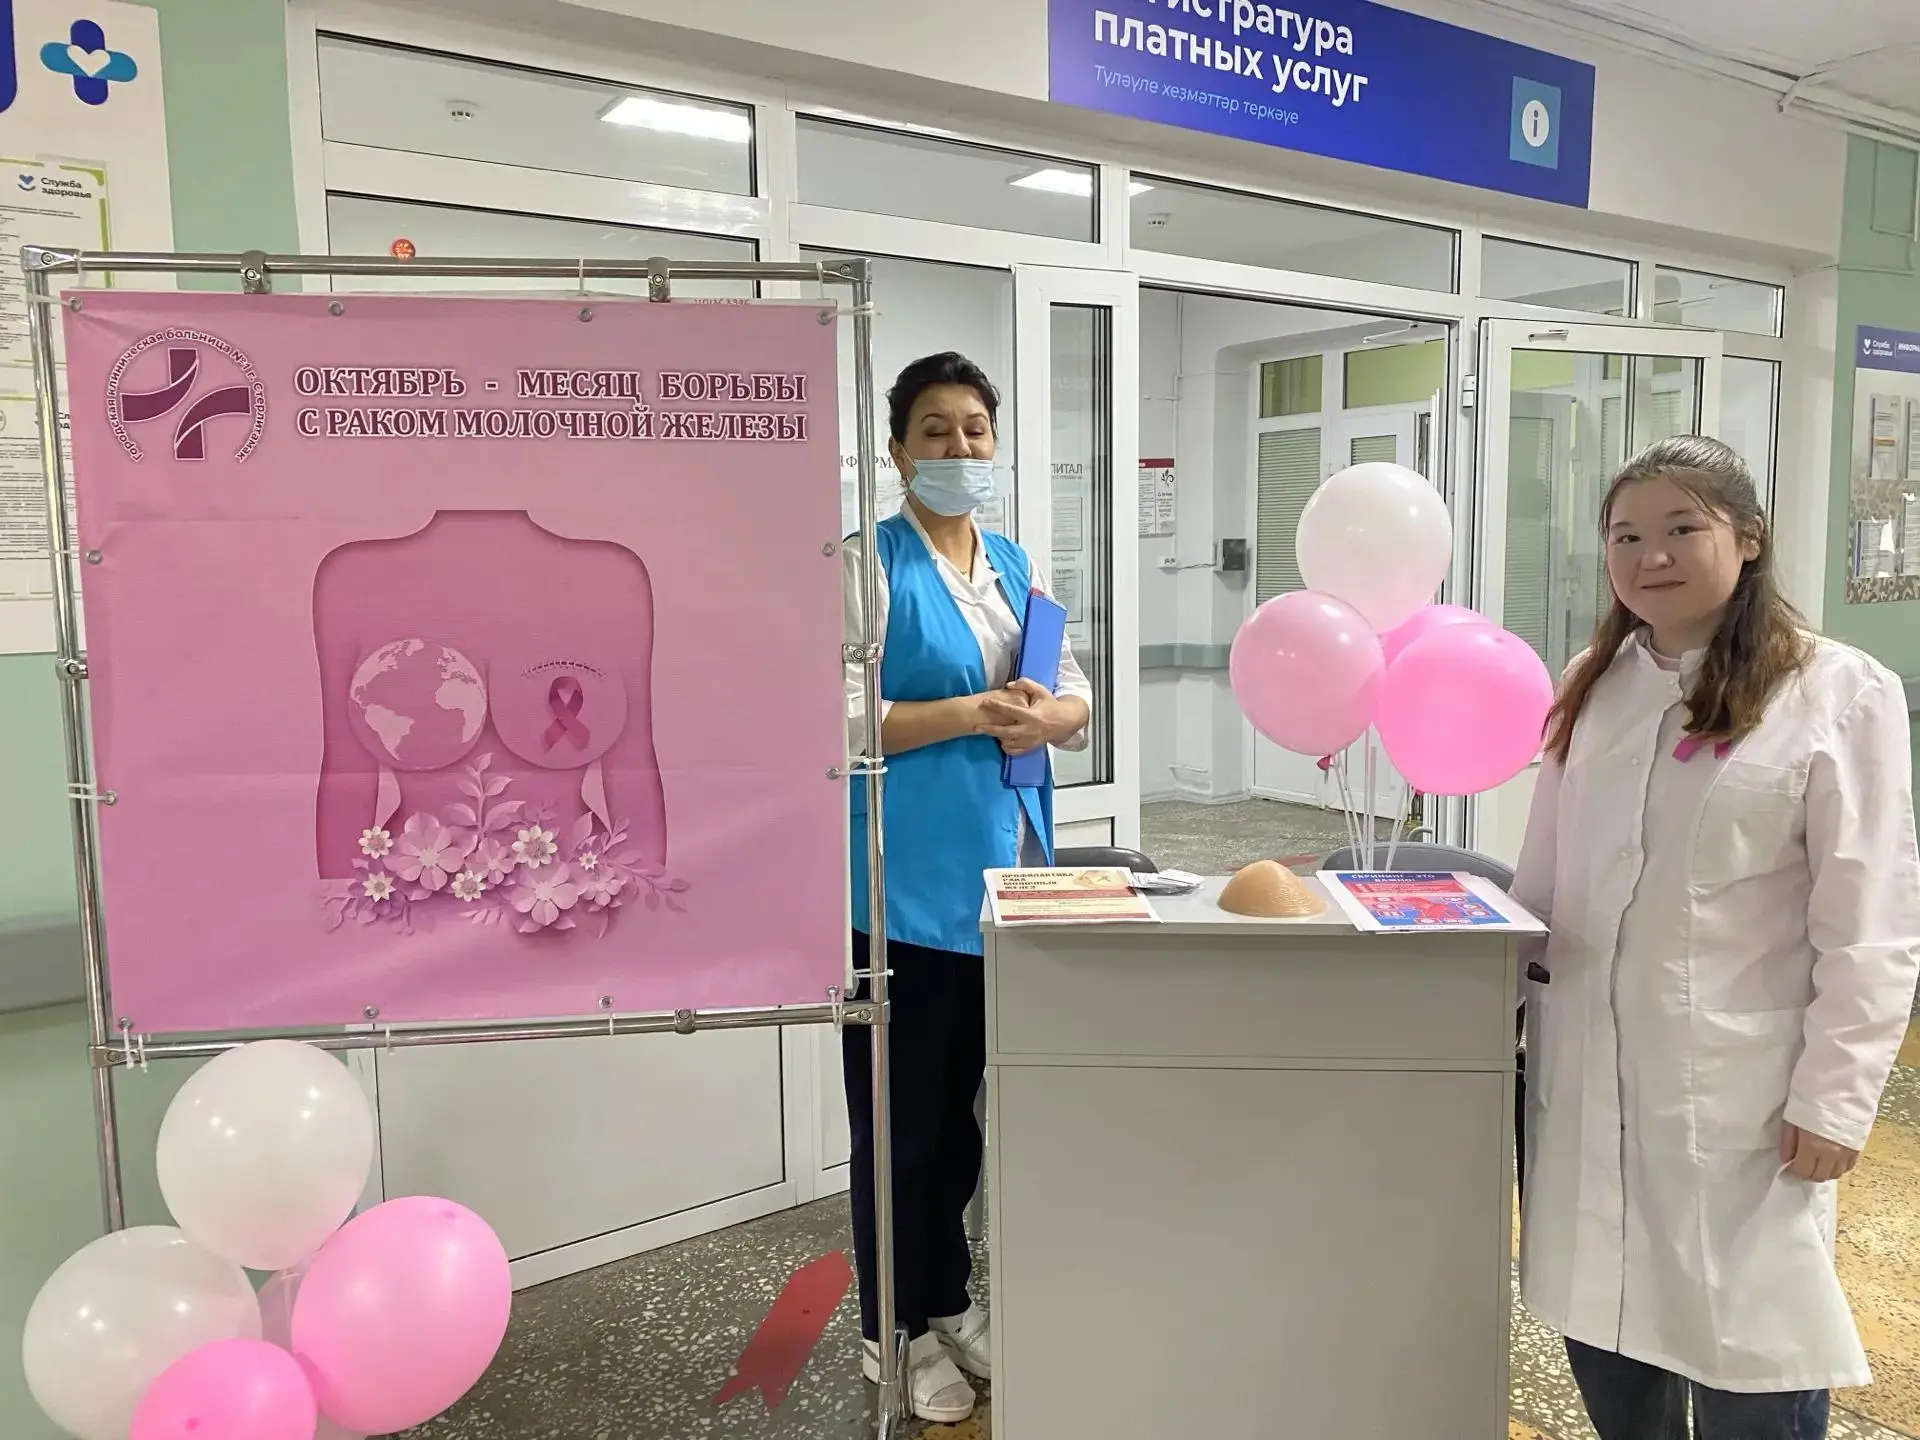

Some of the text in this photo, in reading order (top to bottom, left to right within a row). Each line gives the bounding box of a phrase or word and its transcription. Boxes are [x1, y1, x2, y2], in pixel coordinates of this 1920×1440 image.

[1095, 9, 1369, 108] платных услуг
[1094, 64, 1159, 94] Түләүле
[1244, 100, 1299, 126] теркәүе
[40, 177, 82, 189] Служба
[41, 187, 92, 199] здоровья
[107, 330, 164, 397] клиническая
[166, 328, 231, 355] больница
[295, 366, 466, 396] ОКТЯБРЬ
[517, 370, 642, 406] МЕСЯЦ
[659, 371, 807, 402] БОРЬБЫ
[107, 398, 144, 463] Городская
[234, 382, 267, 463] Стерлитамак
[297, 404, 808, 441] С РАКОМ МОЛОЧНОЙ ЖЕЛЕЗЫ
